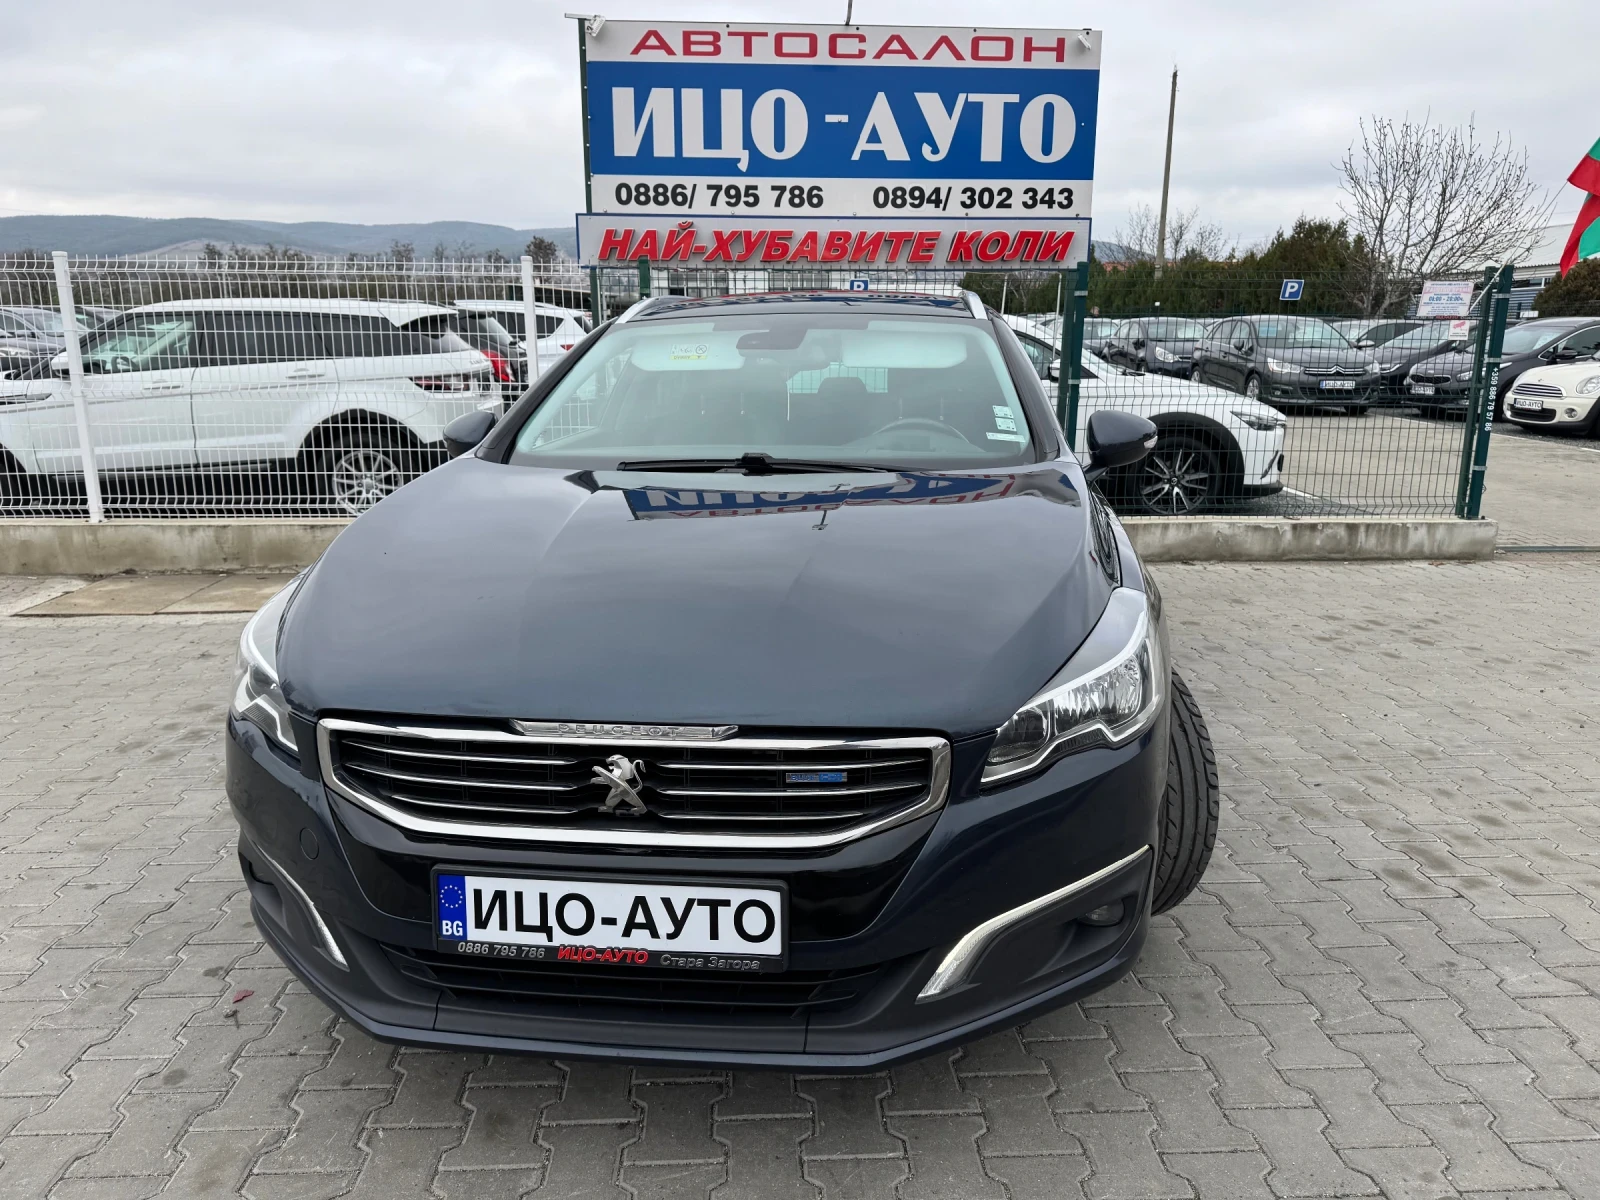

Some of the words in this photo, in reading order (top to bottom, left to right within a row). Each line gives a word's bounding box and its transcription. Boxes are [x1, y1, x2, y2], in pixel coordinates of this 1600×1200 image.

[630, 30, 1066, 62] АВТОСАЛОН
[615, 182, 697, 209] 0886/
[706, 184, 760, 207] 795
[770, 185, 824, 208] 786
[873, 186, 952, 211] 0894/
[960, 187, 1013, 209] 302
[1021, 187, 1074, 209] 343
[599, 220, 942, 263] НАЙ-ХУБАВИТЕ
[946, 229, 1076, 263] КОЛИ
[1284, 282, 1299, 298] P
[1491, 367, 1499, 385] +359
[558, 723, 680, 738] PEUGEOT
[442, 920, 463, 936] BG
[473, 888, 775, 943] ИЦО-АУТО
[457, 942, 489, 954] 0886
[493, 944, 517, 957] 795
[521, 946, 546, 959] 786
[556, 945, 649, 964] ИЦО-АУТО
[660, 953, 704, 968] Стара
[708, 956, 761, 971] Загора
